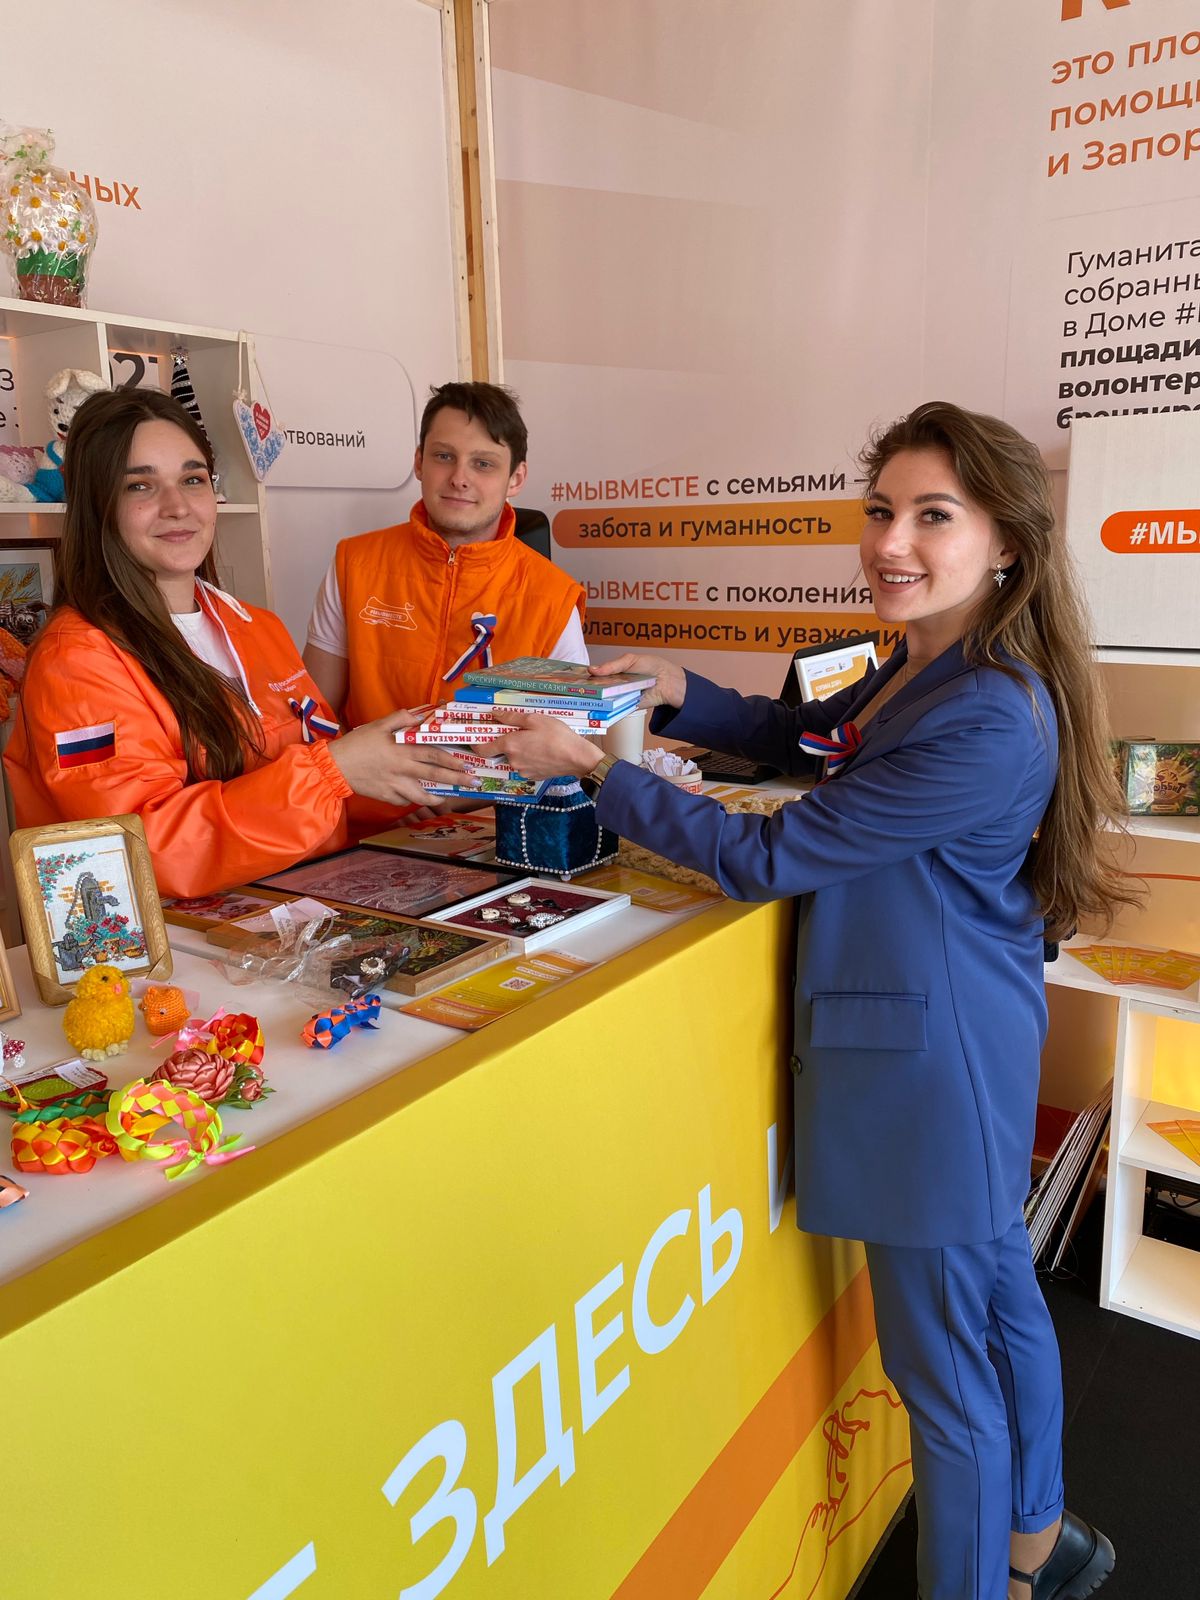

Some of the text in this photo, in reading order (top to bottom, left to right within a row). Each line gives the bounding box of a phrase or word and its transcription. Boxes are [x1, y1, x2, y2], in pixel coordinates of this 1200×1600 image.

[1051, 31, 1200, 85] это пло
[1050, 79, 1200, 132] помощ
[1047, 127, 1200, 178] и Запор
[1067, 239, 1200, 278] Гуманита
[1064, 273, 1200, 306] собранн
[1063, 321, 1078, 337] в
[1084, 309, 1166, 339] Доме
[1060, 338, 1200, 369] площади
[1058, 370, 1200, 399] волонтер
[283, 429, 366, 449] твований
[551, 475, 700, 501] #МЫВМЕСТЕ
[706, 479, 719, 496] с
[726, 473, 846, 495] семьями
[578, 515, 832, 541] забота и гуманность
[581, 581, 874, 604] ЫВМЕСТЕ с поколения
[754, 624, 769, 642] и
[776, 626, 908, 648] уважеи
[467, 674, 497, 685] РУССКИЕ
[499, 678, 537, 689] НАРОДНЫЕ
[539, 682, 568, 693] СКАЗКИ
[381, 1183, 744, 1600] ЗДЕСЬ
